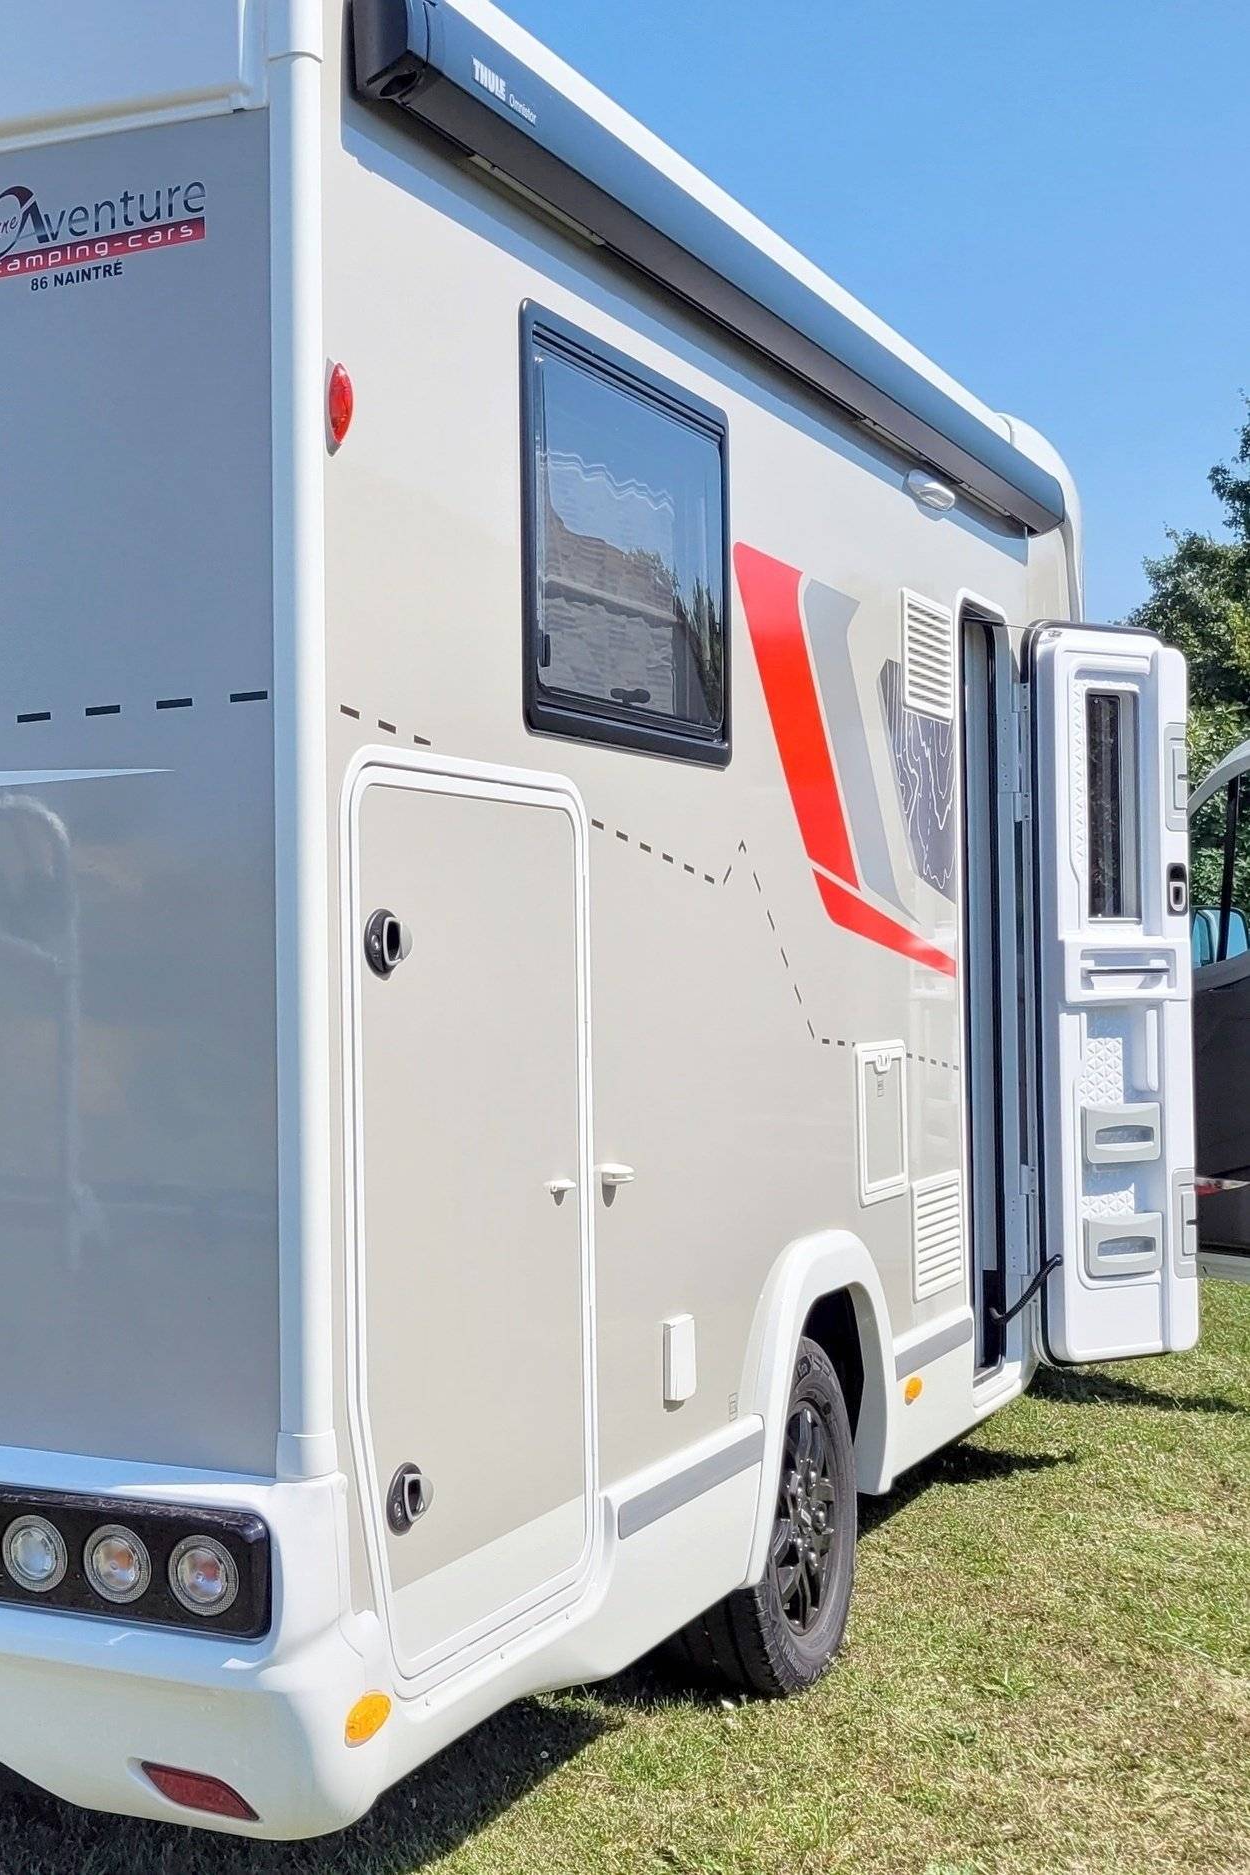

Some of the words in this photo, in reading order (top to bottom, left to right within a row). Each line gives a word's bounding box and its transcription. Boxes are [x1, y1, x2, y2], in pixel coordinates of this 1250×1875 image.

[472, 57, 506, 101] THULE
[16, 181, 206, 244] Aventure
[30, 276, 49, 292] 86
[53, 259, 124, 288] NAINTRÉ
